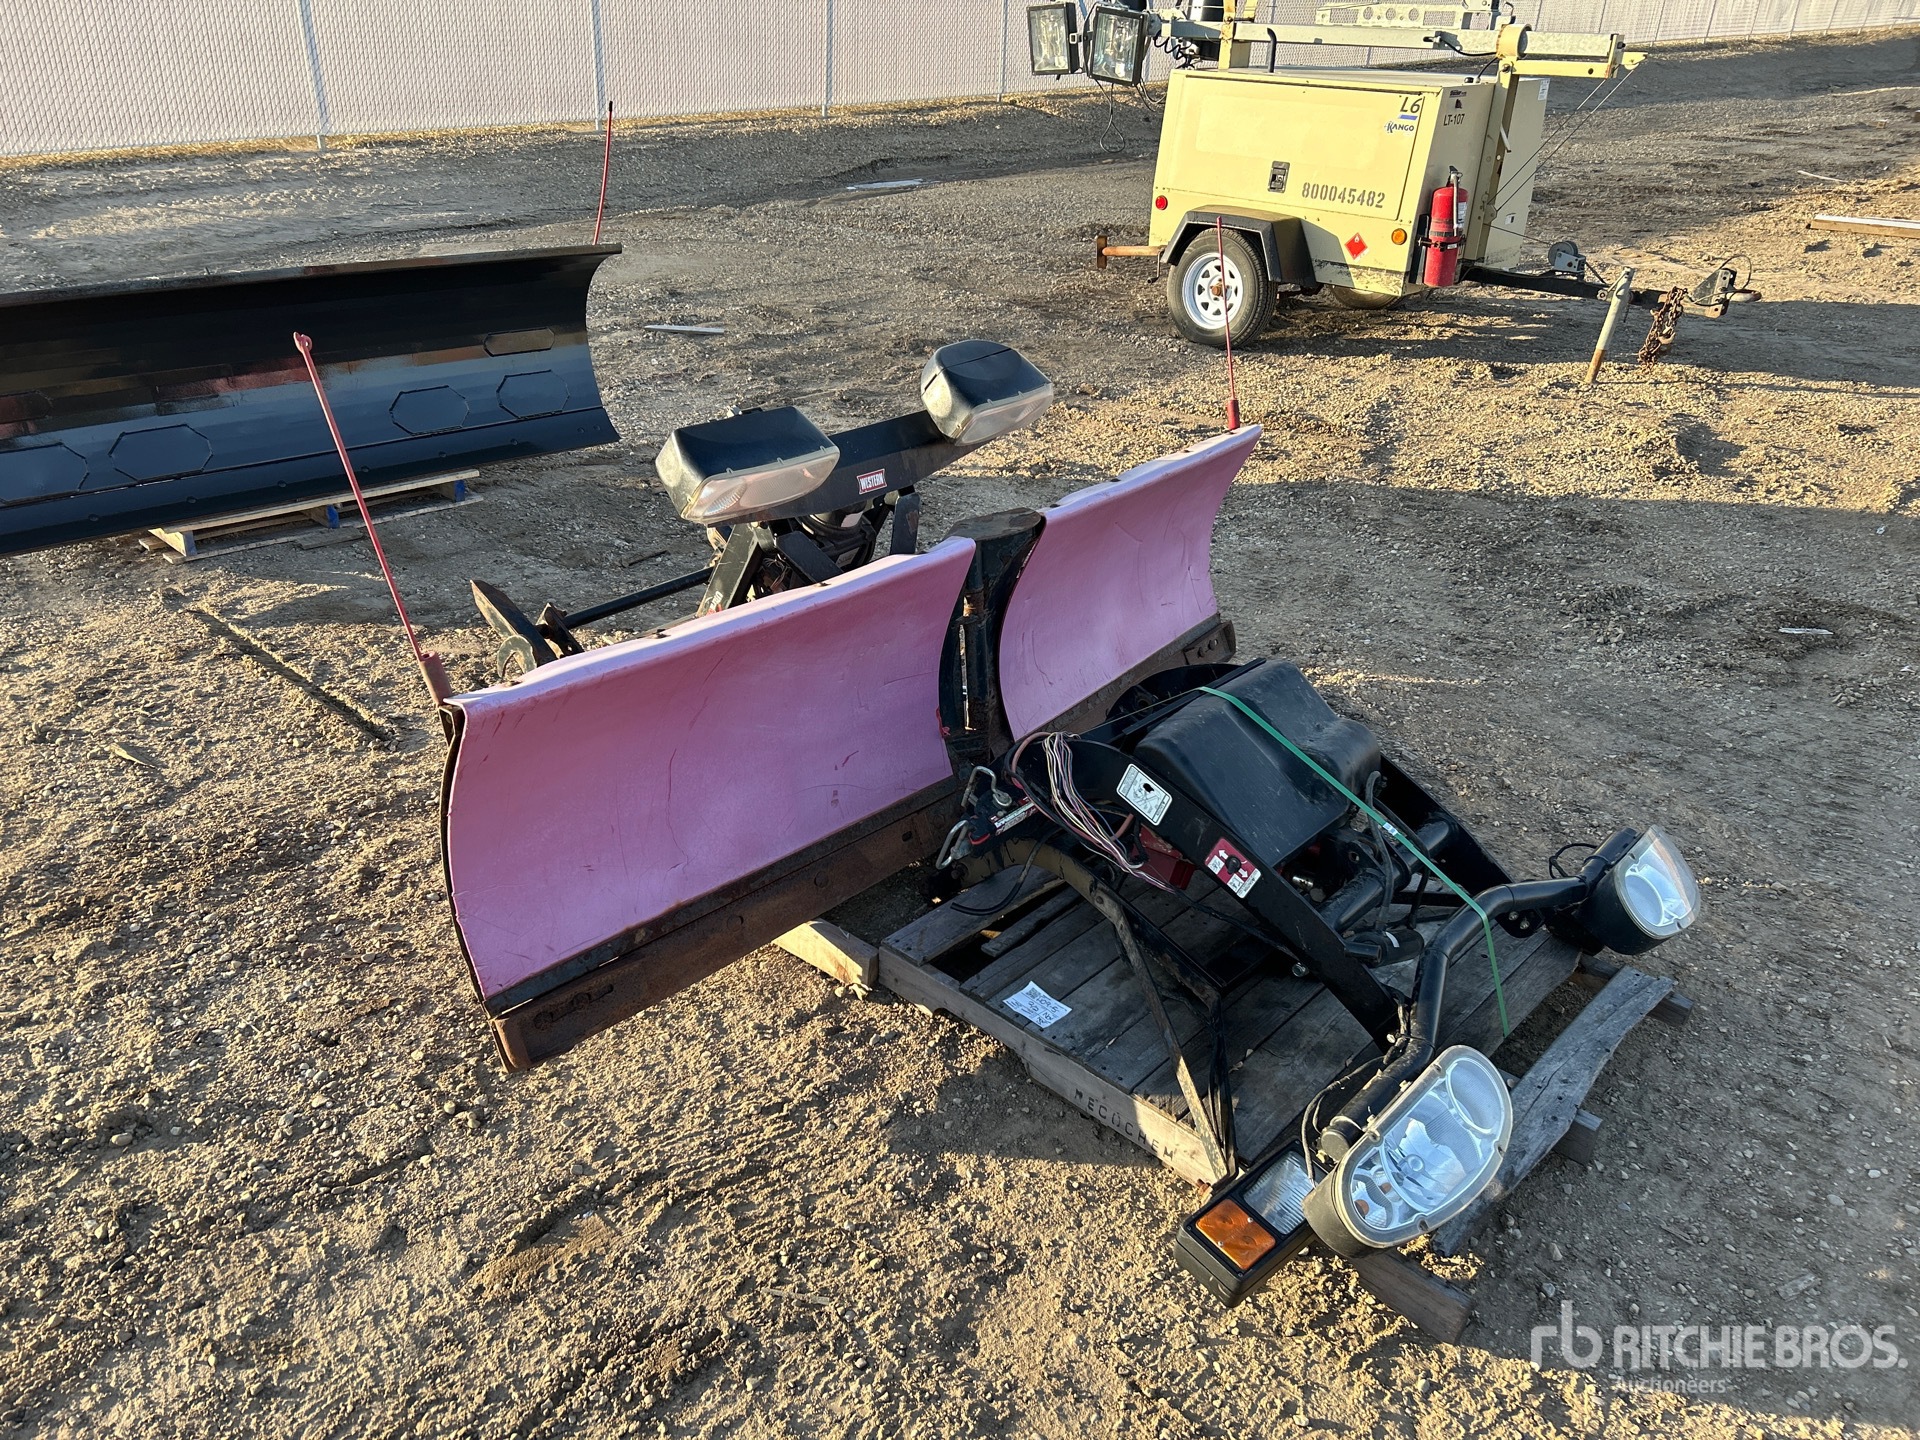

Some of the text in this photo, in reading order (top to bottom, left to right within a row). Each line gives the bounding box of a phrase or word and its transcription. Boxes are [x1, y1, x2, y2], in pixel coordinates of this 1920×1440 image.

[1400, 96, 1422, 114] L6
[1443, 113, 1466, 127] LT-107
[1302, 182, 1385, 208] 800045482
